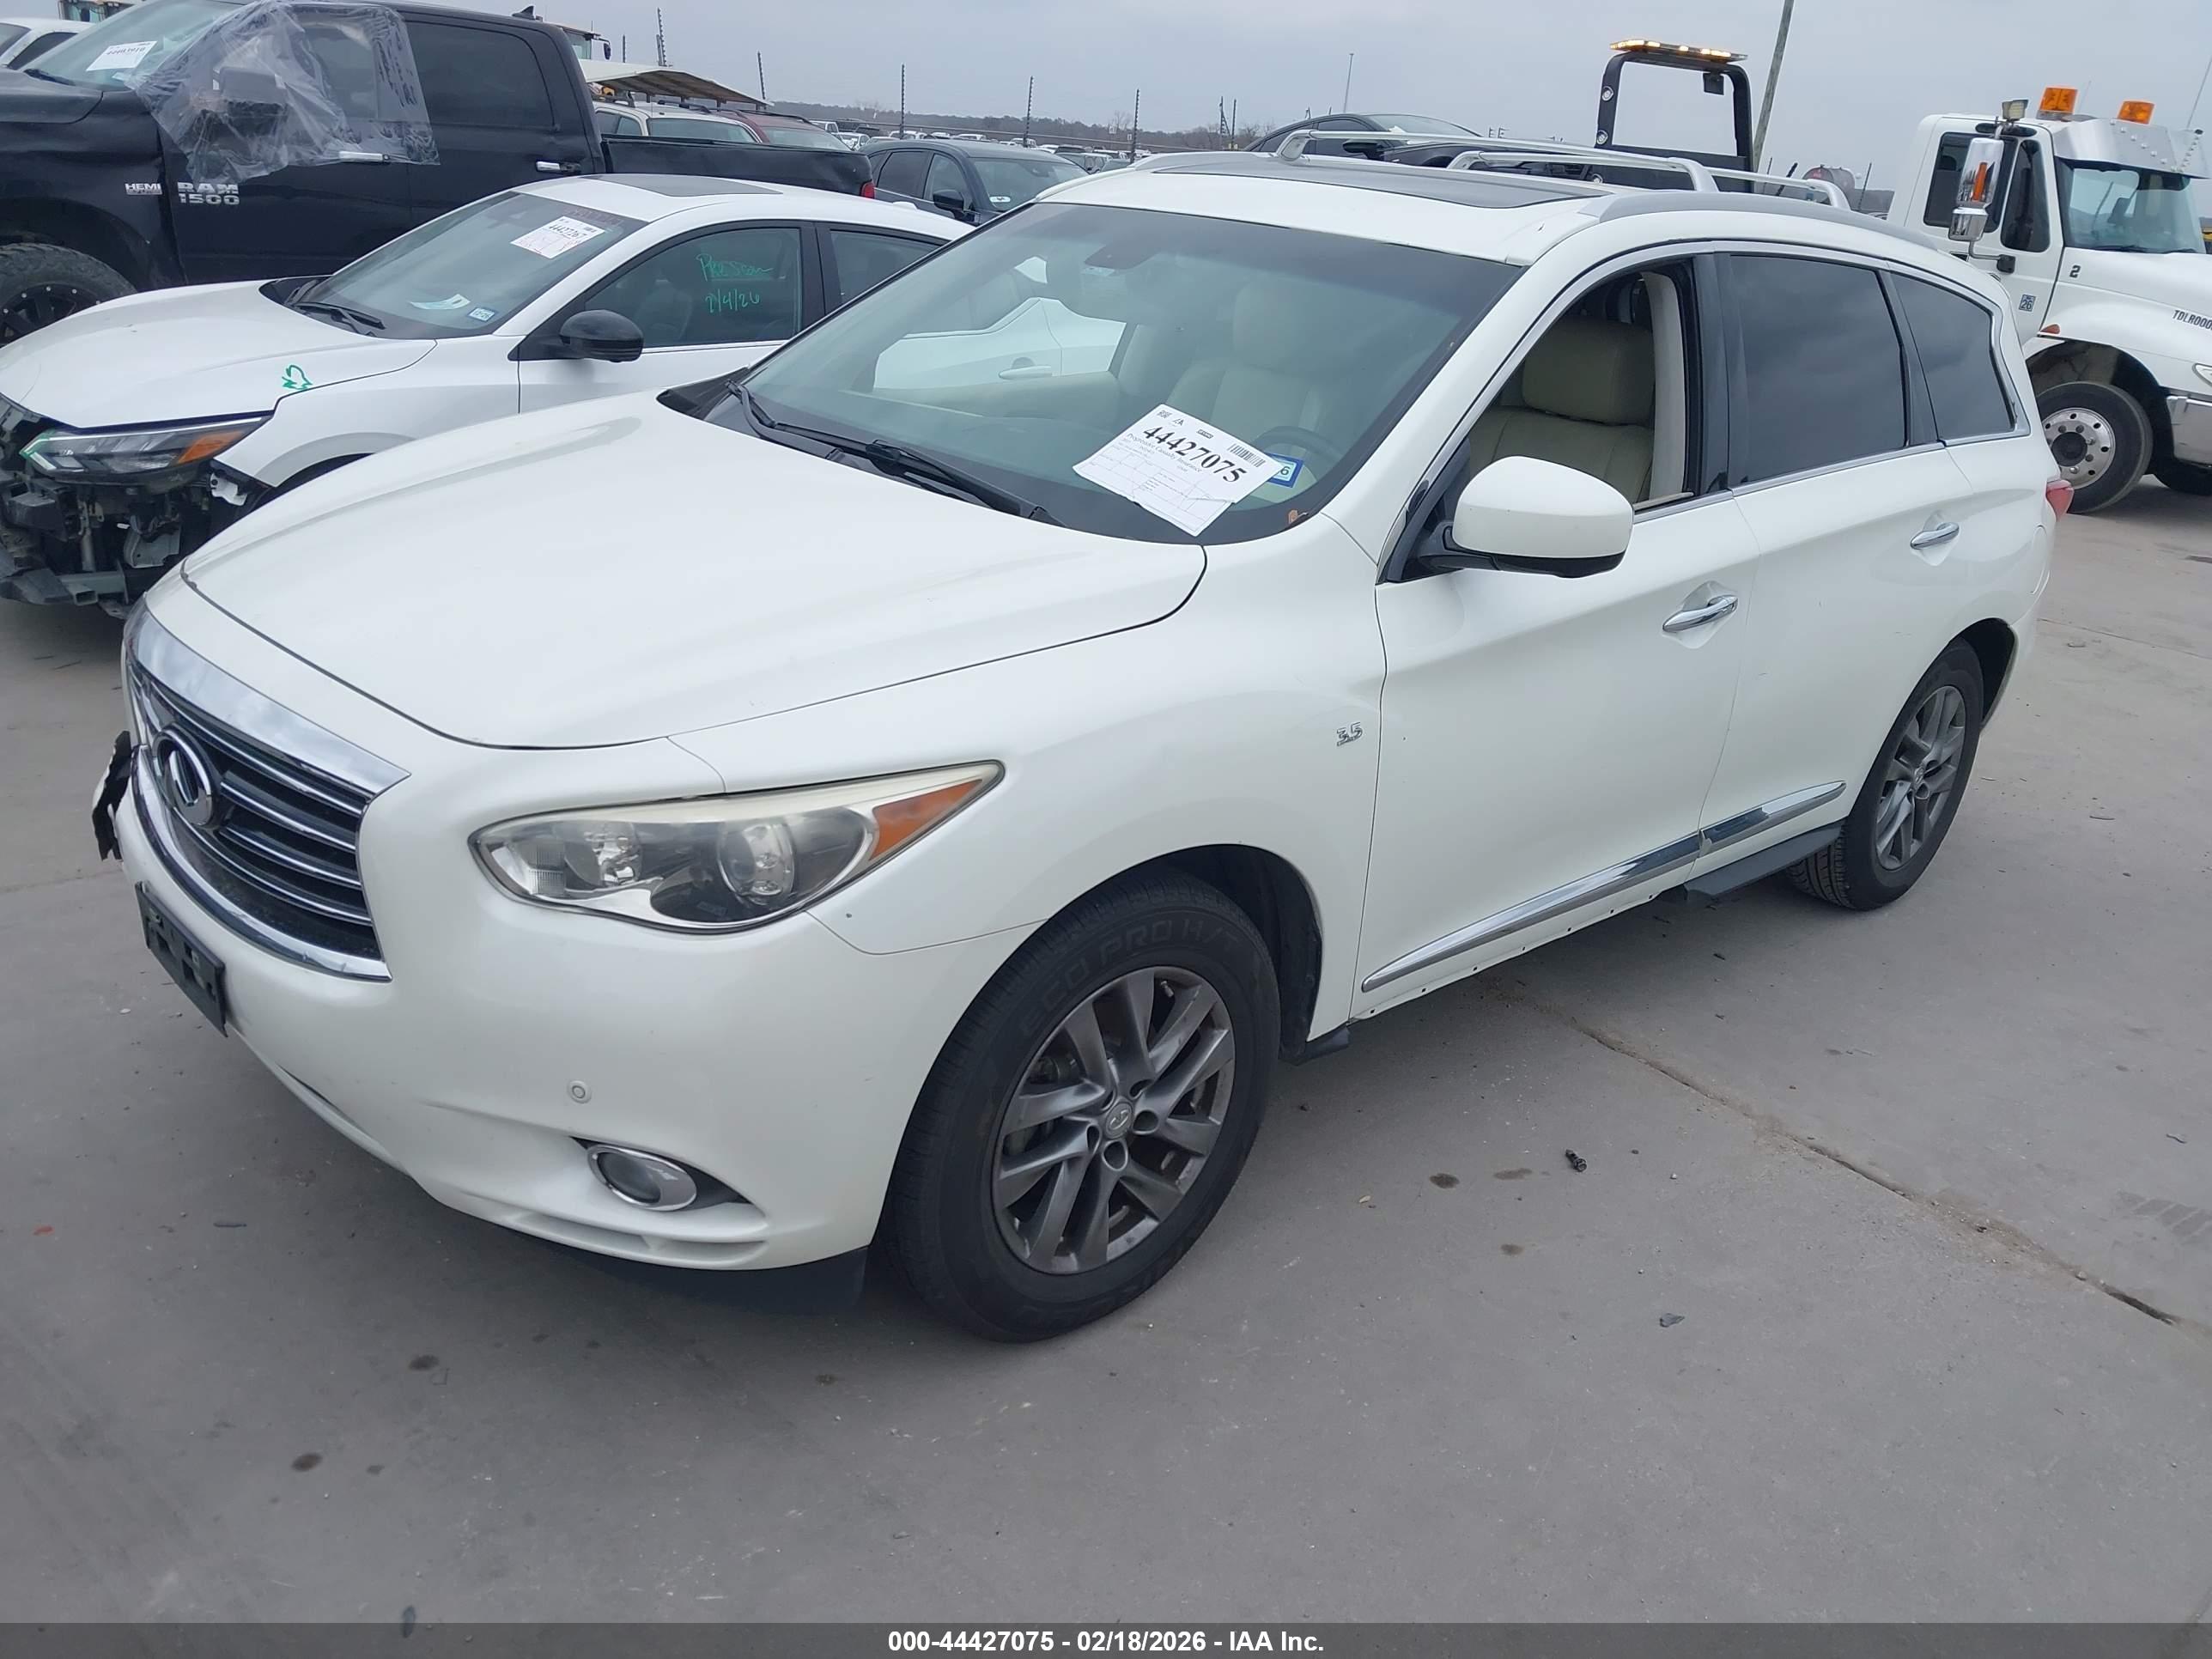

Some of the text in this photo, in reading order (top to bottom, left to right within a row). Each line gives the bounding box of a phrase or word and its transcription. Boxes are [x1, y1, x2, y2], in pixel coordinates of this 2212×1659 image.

[177, 182, 239, 194] RAM
[178, 193, 240, 205] 1500
[2069, 264, 2081, 278] 2
[2021, 299, 2033, 310] 26
[2172, 309, 2212, 331] TDLR000
[1142, 426, 1248, 483] 44427075
[1098, 920, 1173, 966] PRO
